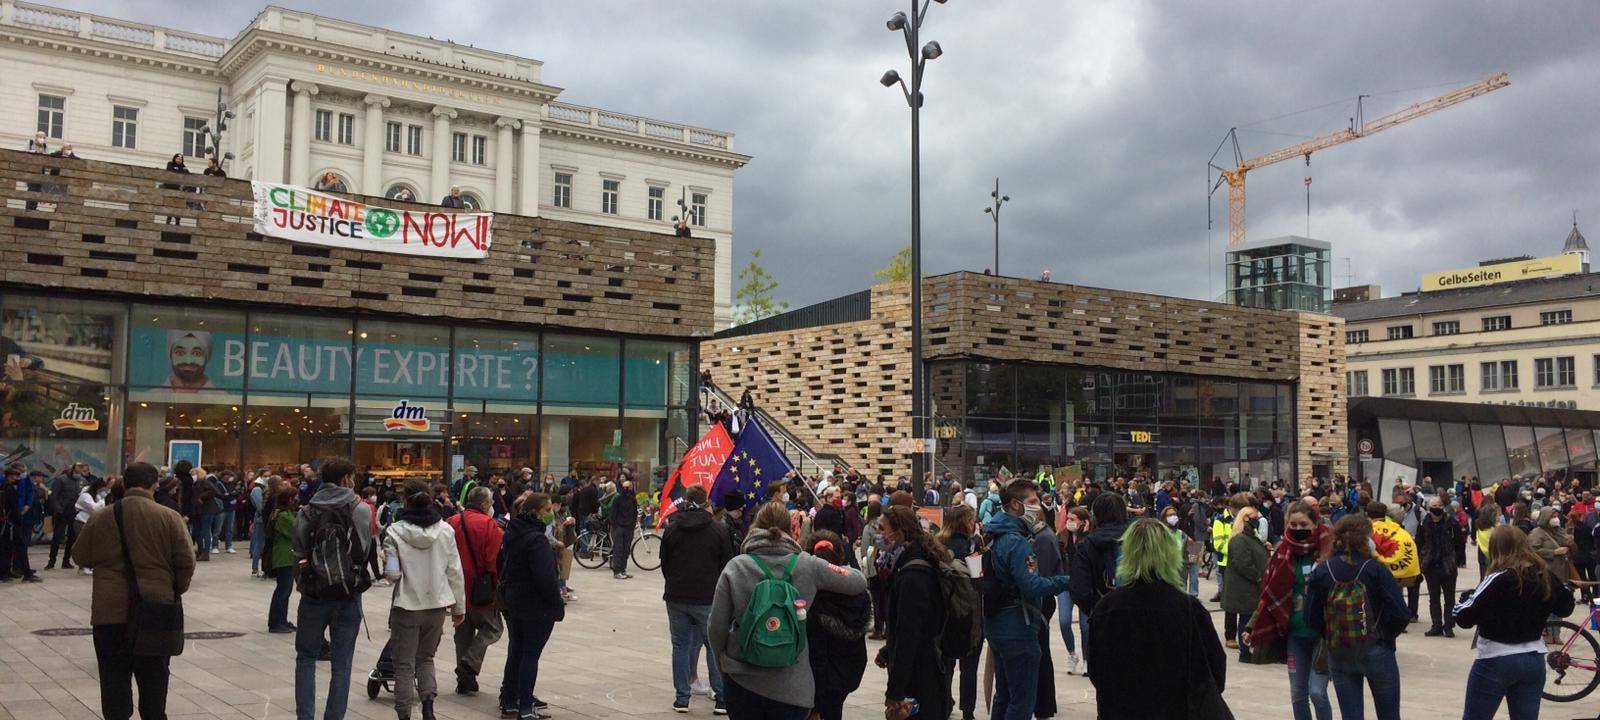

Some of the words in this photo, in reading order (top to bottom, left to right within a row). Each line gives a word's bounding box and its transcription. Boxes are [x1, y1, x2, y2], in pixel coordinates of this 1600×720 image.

[269, 187, 366, 222] CLIMATE
[272, 208, 363, 239] JUSTICE
[403, 210, 489, 251] NOW!
[1438, 271, 1501, 286] GelbeSeiten
[224, 339, 363, 382] BEAUTY
[373, 349, 511, 389] EXPERTE
[61, 403, 95, 420] dm
[393, 401, 425, 419] dm
[1390, 541, 1413, 571] DANKE
